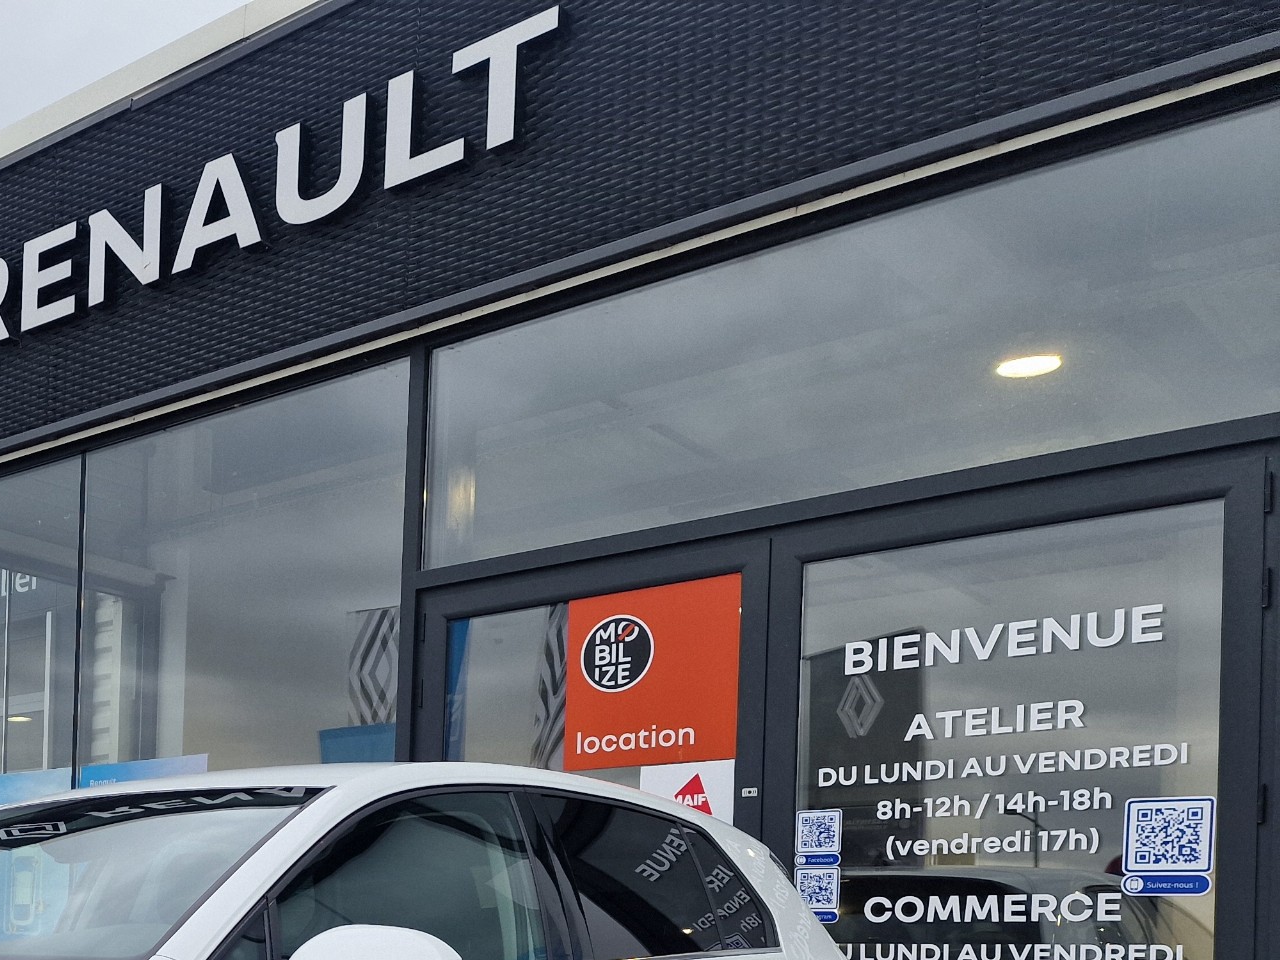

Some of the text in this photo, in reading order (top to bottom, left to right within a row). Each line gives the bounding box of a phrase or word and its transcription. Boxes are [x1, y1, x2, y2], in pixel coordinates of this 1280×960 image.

[844, 603, 1164, 676] BIENVENUE
[904, 699, 1086, 742] ATELIER
[576, 725, 695, 755] location
[818, 742, 1189, 788] DU LUNDI AU VENDREDI
[876, 793, 971, 821] 8h-12h
[995, 786, 1113, 814] 14h-18h
[885, 827, 1100, 861] (vendredi 17h)
[1146, 881, 1194, 889] Suivez-nous
[863, 892, 1122, 924] COMMERCE
